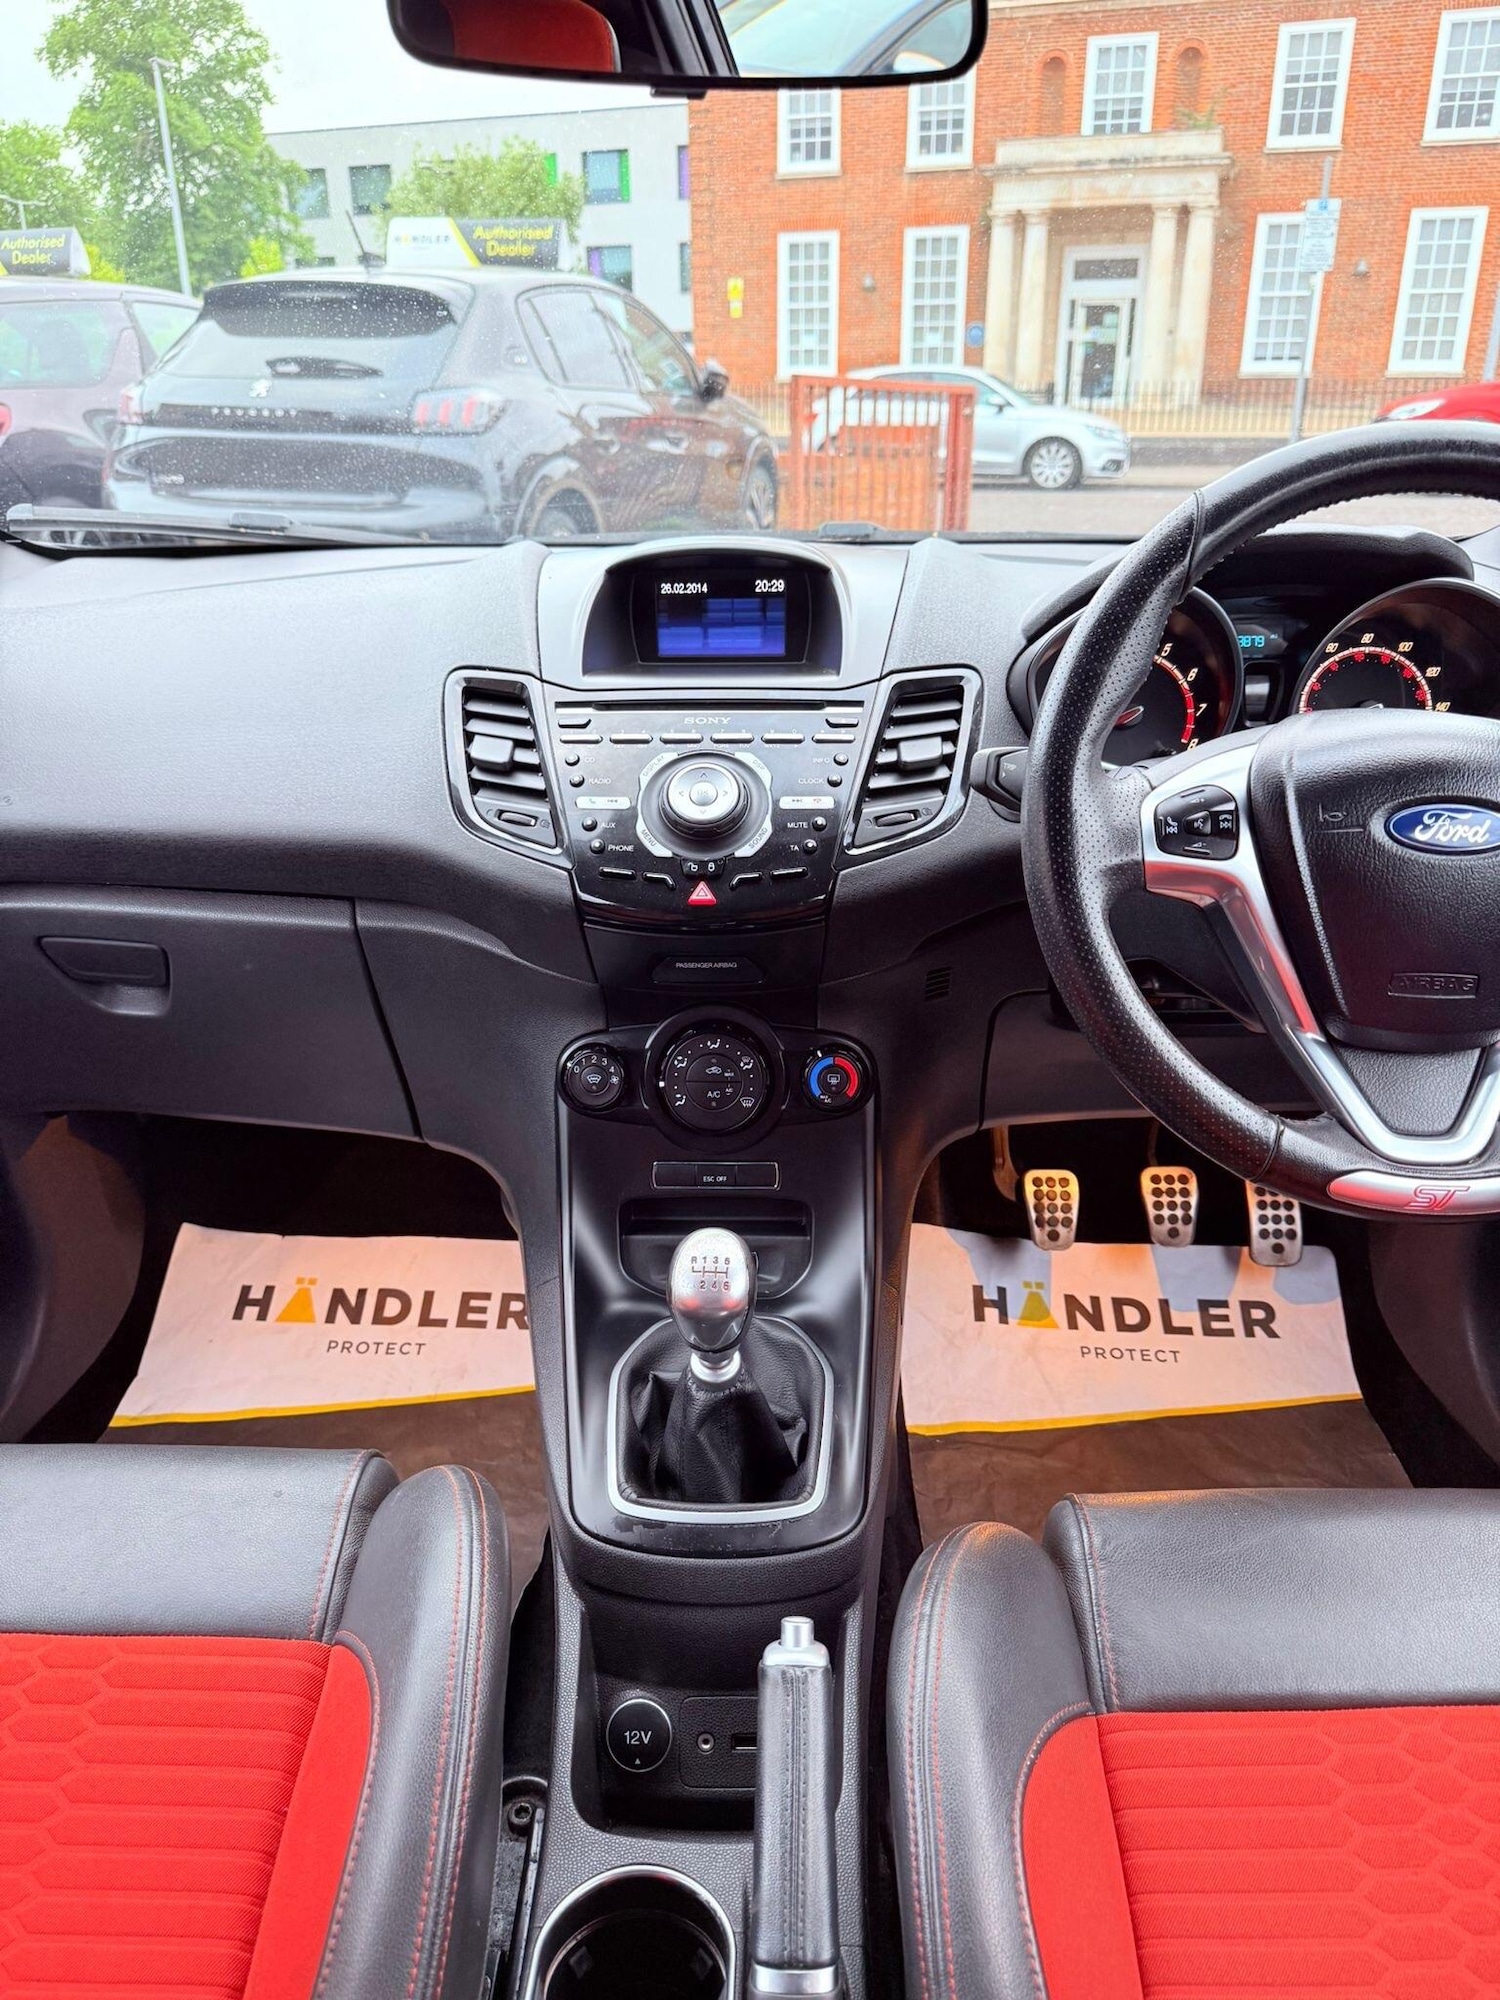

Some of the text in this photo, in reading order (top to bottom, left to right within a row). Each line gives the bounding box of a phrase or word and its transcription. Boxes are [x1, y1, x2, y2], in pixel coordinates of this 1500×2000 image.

[473, 225, 555, 241] Authorised
[1, 233, 66, 250] Authorised
[486, 240, 536, 257] Dealer
[12, 249, 52, 265] Dealer
[660, 583, 708, 594] 26.02.2014
[755, 579, 785, 593] 20:29
[1361, 633, 1375, 644] 80
[1160, 643, 1173, 656] 5
[1398, 642, 1414, 653] 100
[1195, 703, 1208, 717] 7
[1434, 702, 1451, 712] 140
[684, 717, 731, 726] SONY
[589, 777, 612, 785] RADIO
[798, 777, 825, 785] CLOCK
[1414, 810, 1492, 843] Ford
[641, 829, 657, 847] MENU
[748, 827, 768, 849] SOUND
[607, 844, 635, 852] PHONE
[1399, 975, 1477, 992] AIRBAG
[574, 1064, 580, 1073] 0
[591, 1055, 598, 1064] 2
[601, 1057, 608, 1066] 3
[609, 1065, 616, 1073] 4
[707, 1090, 721, 1099] A/C
[1403, 1185, 1471, 1210] ST
[691, 1256, 697, 1264] R
[713, 1256, 719, 1265] 3
[700, 1280, 730, 1291] 2 4 6
[232, 1277, 529, 1331] HÄNDLER
[972, 1280, 1281, 1339] HÄNDLER
[326, 1340, 427, 1356] PROTECT
[1080, 1346, 1181, 1364] PROTECT
[624, 1730, 652, 1745] 12V
